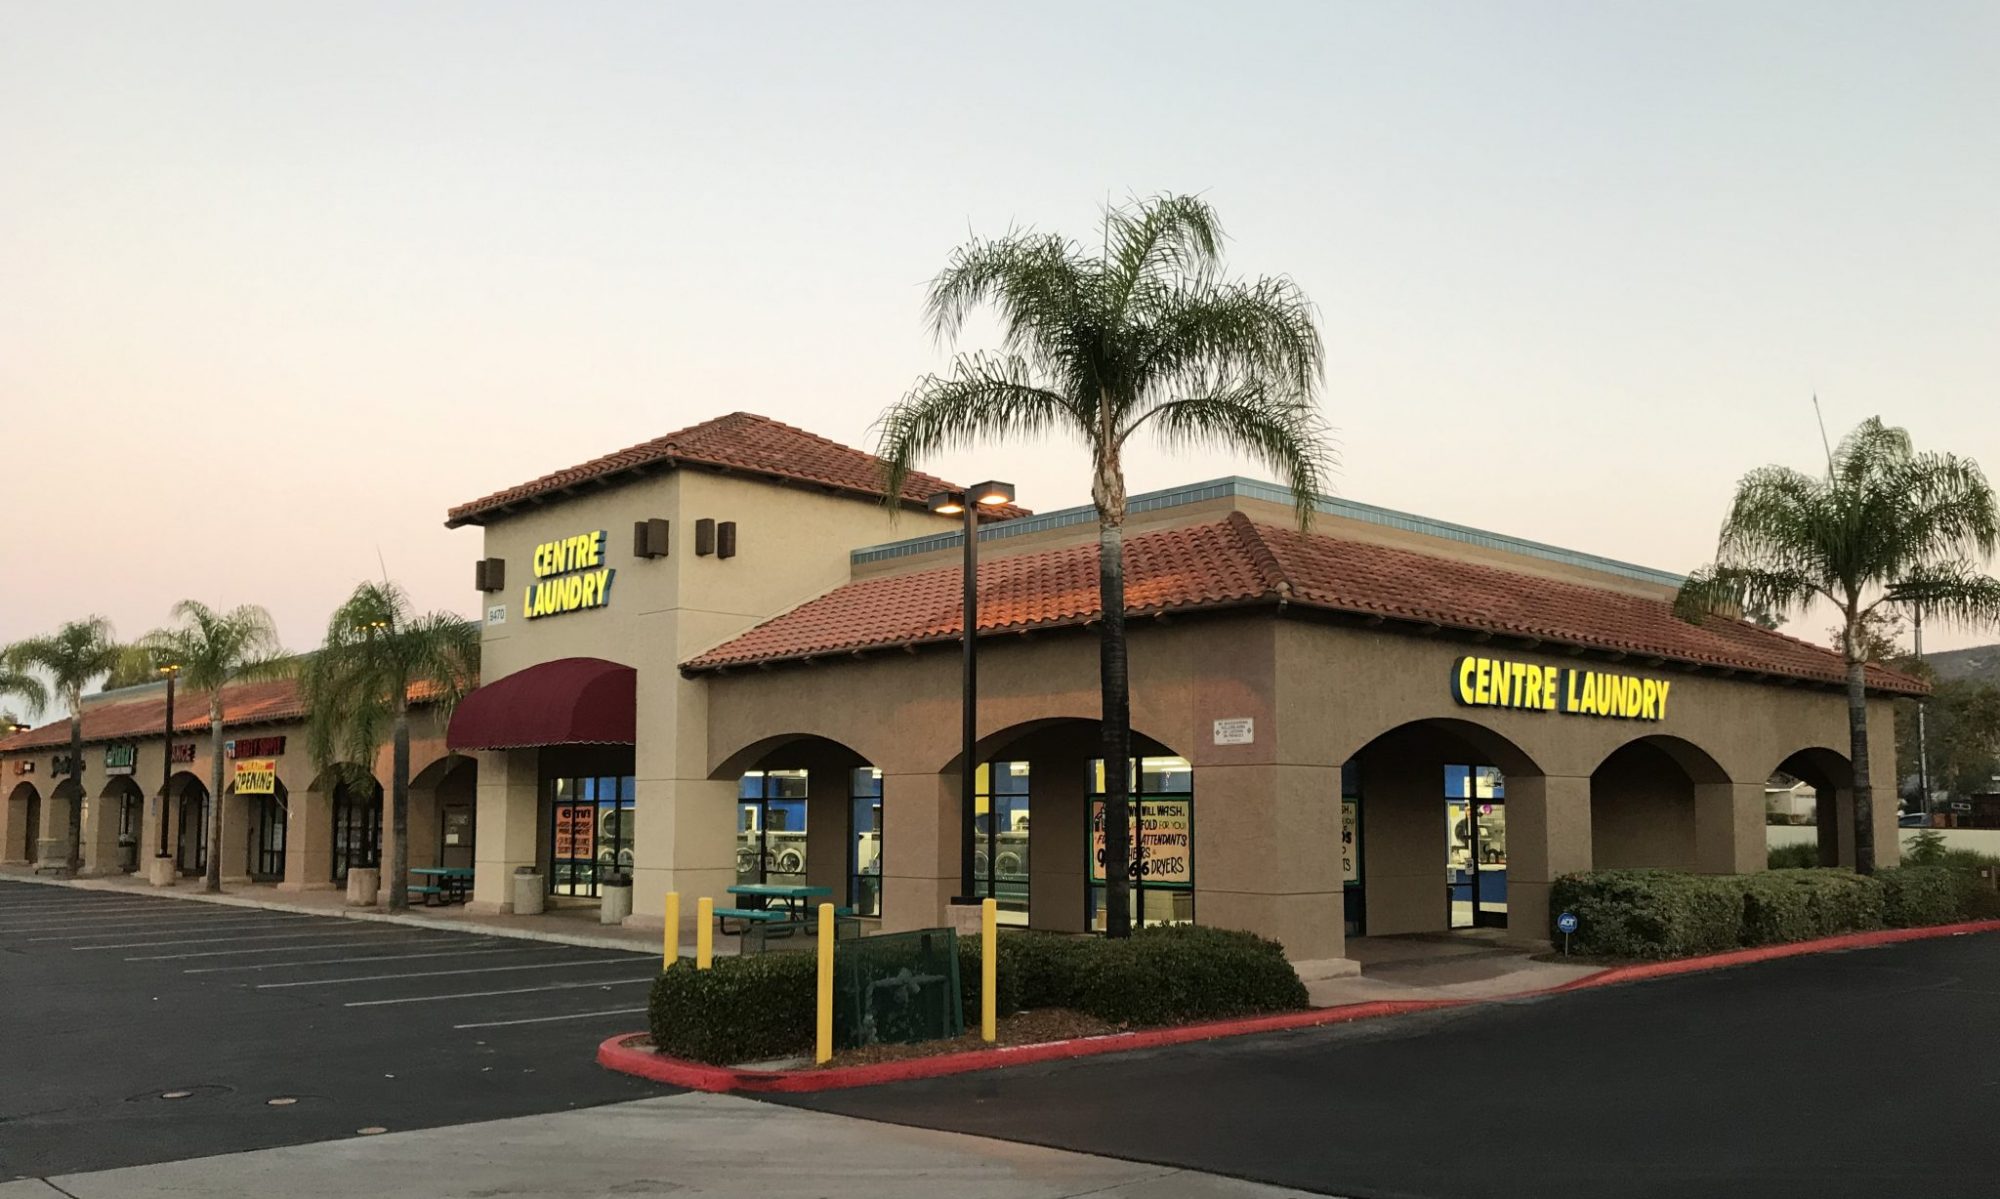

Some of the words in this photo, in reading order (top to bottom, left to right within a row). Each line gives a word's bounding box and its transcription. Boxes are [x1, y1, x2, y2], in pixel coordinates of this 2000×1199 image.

[533, 530, 603, 578] CENTRE
[523, 569, 612, 618] LAUNDRY
[1458, 656, 1557, 710] CENTRE
[1565, 669, 1670, 720] LAUNDRY
[235, 771, 274, 791] OPENING
[1141, 805, 1156, 817] WILL
[1157, 804, 1185, 817] WASH.
[1159, 820, 1169, 830] FOR
[1141, 833, 1188, 847] ATTENDANTS
[1151, 856, 1185, 877] DRYERS
[1560, 918, 1575, 927] ADT
